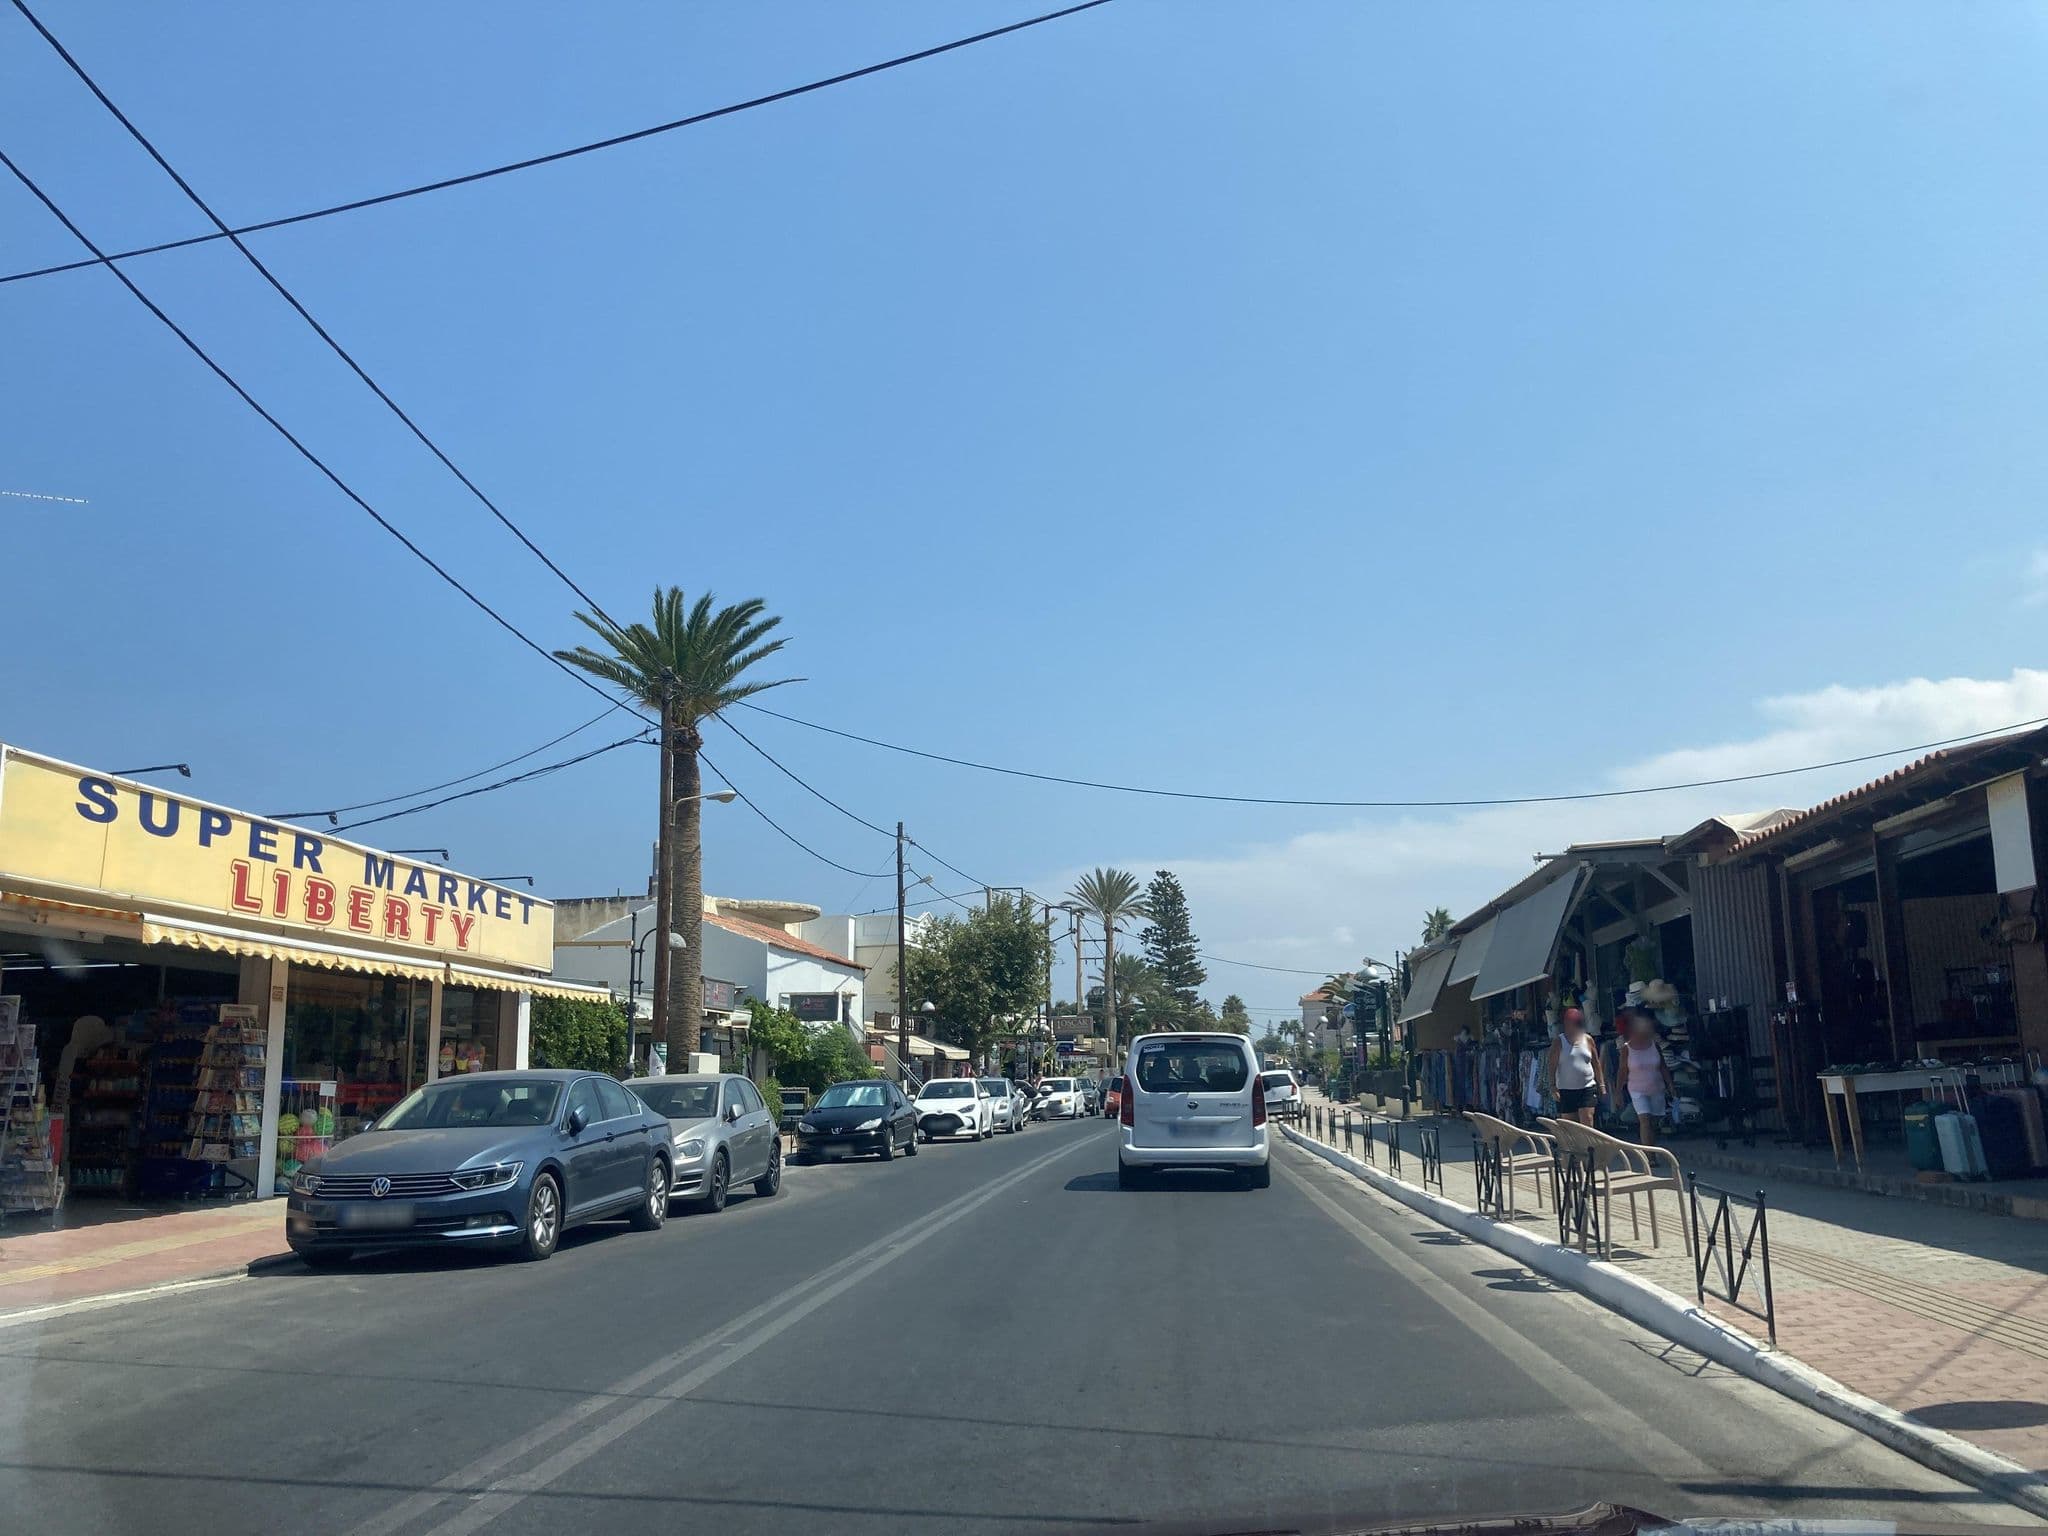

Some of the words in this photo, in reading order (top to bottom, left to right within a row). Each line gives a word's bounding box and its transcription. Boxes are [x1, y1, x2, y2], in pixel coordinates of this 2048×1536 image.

[75, 776, 324, 874] SUPER
[364, 852, 535, 925] MARKET
[231, 858, 475, 951] LIBERTY
